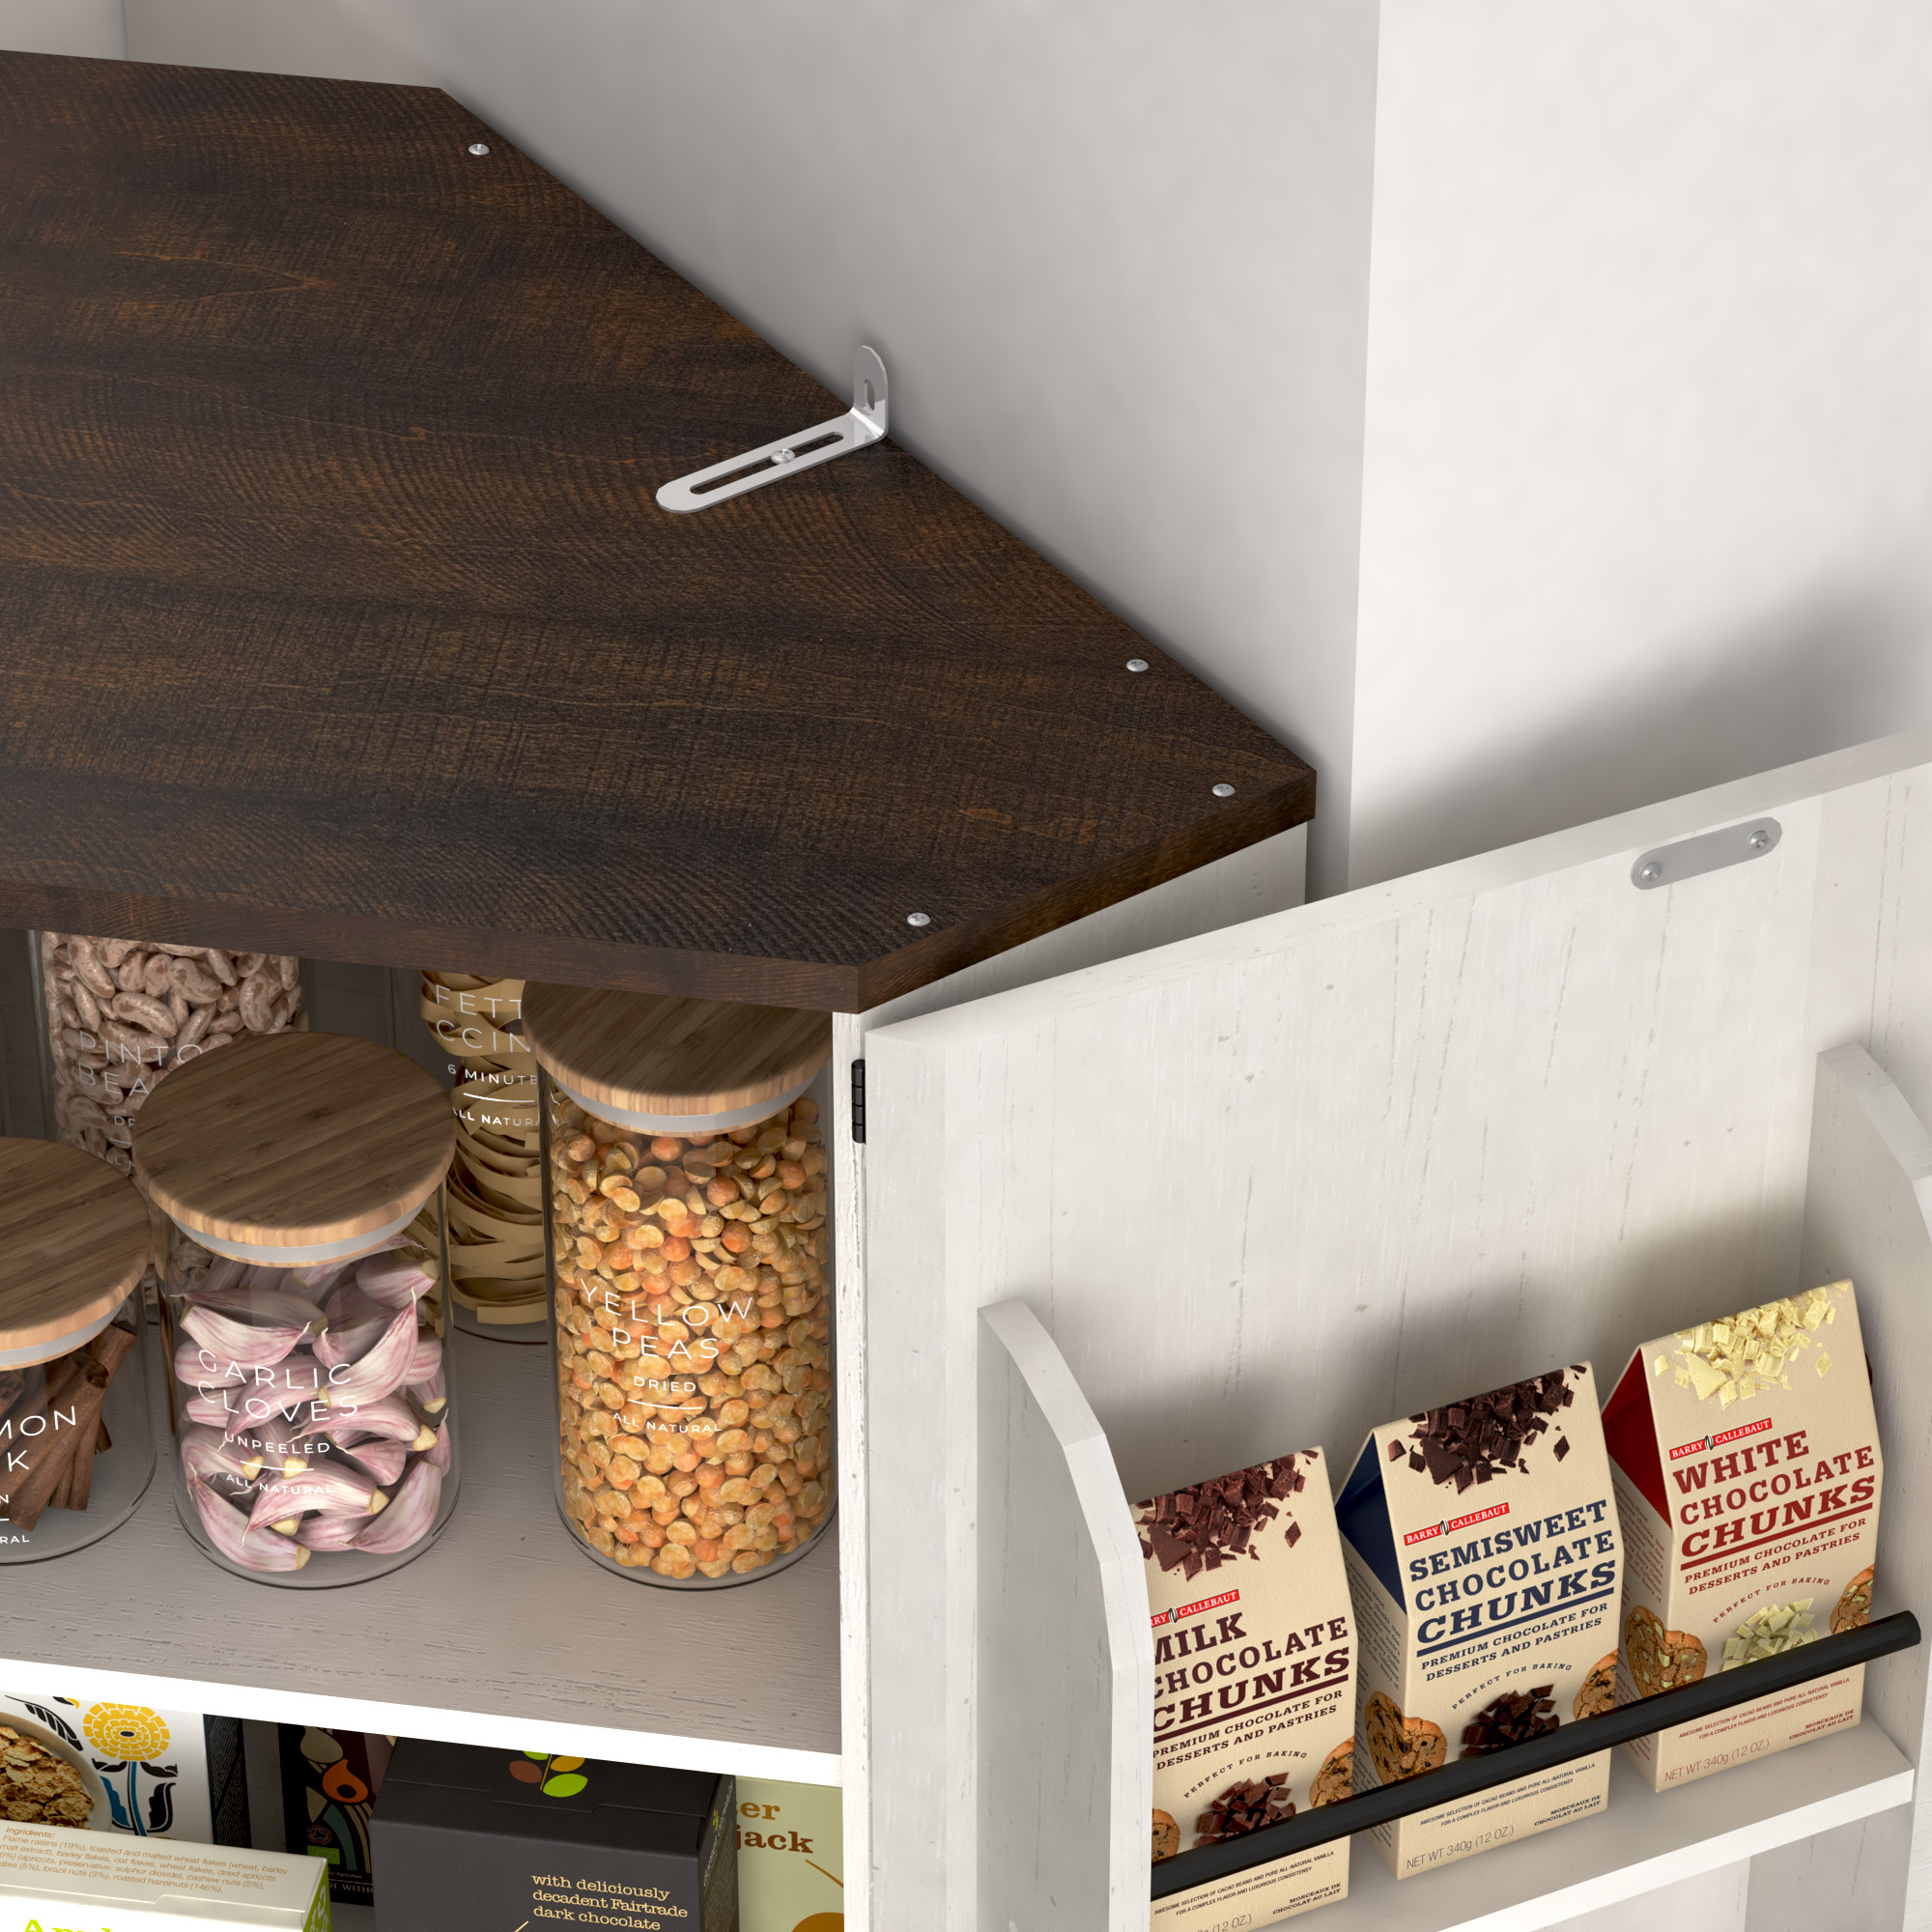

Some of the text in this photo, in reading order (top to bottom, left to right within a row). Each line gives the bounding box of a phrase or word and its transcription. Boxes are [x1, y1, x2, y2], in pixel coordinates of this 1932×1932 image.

[447, 1064, 457, 1075] 6
[581, 1278, 753, 1326] YELLOW
[612, 1326, 720, 1360] PEAS
[198, 1350, 352, 1389] GARLIC
[634, 1376, 696, 1392] DRIED
[198, 1380, 358, 1422] CLOVES
[224, 1431, 330, 1454] UNPEELED
[612, 1412, 722, 1434] ALL NATURAL
[1671, 1419, 1770, 1458] BARRY CALLEBAUT
[1672, 1430, 1809, 1494] WHITE
[226, 1474, 334, 1495] ALL NATURAL
[1680, 1445, 1874, 1525] CHOCOLATE
[1406, 1505, 1507, 1545] BARRY CALLEBAUT
[1682, 1474, 1875, 1557] CHUNKS
[1408, 1499, 1607, 1582] SEMISWEET
[1684, 1518, 1866, 1584] PREMIUM CHOCOLATE FOR
[1415, 1529, 1615, 1611] CHOCOLATE
[1689, 1532, 1861, 1596] DESSERTS AND PASTRIES
[1179, 1591, 1237, 1617] CALLEBAUT
[1417, 1559, 1616, 1644] CHUNKS
[1713, 1577, 1831, 1624] PERFECT FOR BAKING
[1421, 1603, 1608, 1670] PREMIUM CHOCOLATE FOR
[1426, 1617, 1603, 1682] DESSERTS AND PASTRIES
[1154, 1646, 1350, 1732] CHUNKS
[1452, 1662, 1573, 1710] PERFECT FOR BAKING
[1152, 1690, 1343, 1759] PREMIUM CHOCOLATE FOR
[1679, 1726, 1703, 1739] AWESOME
[1704, 1717, 1730, 1730] SELECTION
[1739, 1709, 1755, 1719] CACAO
[1755, 1703, 1773, 1713] BEANS
[1773, 1699, 1783, 1708] AND
[1784, 1695, 1797, 1704] PURE
[1797, 1685, 1830, 1699] ALL-NATURAL
[1830, 1677, 1850, 1688] VANILLA
[1714, 1722, 1737, 1736] COMPLEX
[1738, 1717, 1757, 1727] FLAVOR
[1768, 1704, 1795, 1718] LUXURIOUS
[1789, 1715, 1854, 1740] CHOCOLAT AU LAIT
[1804, 1713, 1843, 1729] MORCEAUX
[1156, 1704, 1338, 1771] DESSERTS AND PASTRIES
[1183, 1750, 1308, 1798] PERFECT FOR BAKING
[1664, 1738, 1770, 1782] NET WT 340g (12 OZ.)
[1420, 1813, 1445, 1826] AWESOME
[1446, 1804, 1473, 1817] SELECTION
[1481, 1796, 1498, 1804] CACAO
[1498, 1790, 1516, 1800] BEANS
[1527, 1781, 1541, 1790] PURE
[1575, 1763, 1595, 1774] VANILLA
[1456, 1809, 1480, 1822] COMPLEX
[1480, 1804, 1500, 1814] FLAVOR
[1500, 1799, 1511, 1807] AND
[1511, 1790, 1539, 1804] LUXURIOUS
[1534, 1811, 1572, 1827] CHOCOLAT
[1583, 1801, 1601, 1810] LAIT
[1550, 1799, 1588, 1815] MORCEAUX
[6, 1826, 55, 1838] Ingridients:
[1406, 1825, 1515, 1869] NET WT 340g (12 OZ.)
[2, 1834, 29, 1844] Flame
[30, 1838, 58, 1847] raisins
[89, 1846, 122, 1855] toasted
[142, 1852, 172, 1861] malted
[174, 1855, 200, 1863] wheat
[202, 1859, 227, 1867] flakes
[228, 1862, 260, 1872] (wheat,
[262, 1865, 289, 1876] barley
[56, 1850, 82, 1860] barley
[84, 1854, 111, 1863] flakes,
[129, 1859, 156, 1868] flakes,
[159, 1862, 186, 1872] wheat
[187, 1865, 214, 1876] flakes,
[217, 1868, 241, 1878] dried
[242, 1872, 276, 1883] apricots
[59, 1859, 113, 1871] preservative:
[115, 1865, 147, 1875] sulphur
[186, 1874, 220, 1885] cashew
[222, 1878, 242, 1887] nuts
[43, 1865, 67, 1874] brazil
[113, 1874, 147, 1884] roasted
[148, 1878, 189, 1889] hazelnuts
[531, 1874, 670, 1902] with deliciously
[1289, 1887, 1329, 1904] MORCEAUX
[532, 1889, 689, 1918] decadent Fairtrade
[533, 1906, 661, 1931] dark chocolate
[1232, 1913, 1252, 1928] OZ.)
[1273, 1889, 1341, 1915] CHOCOLAT AU LAIT
